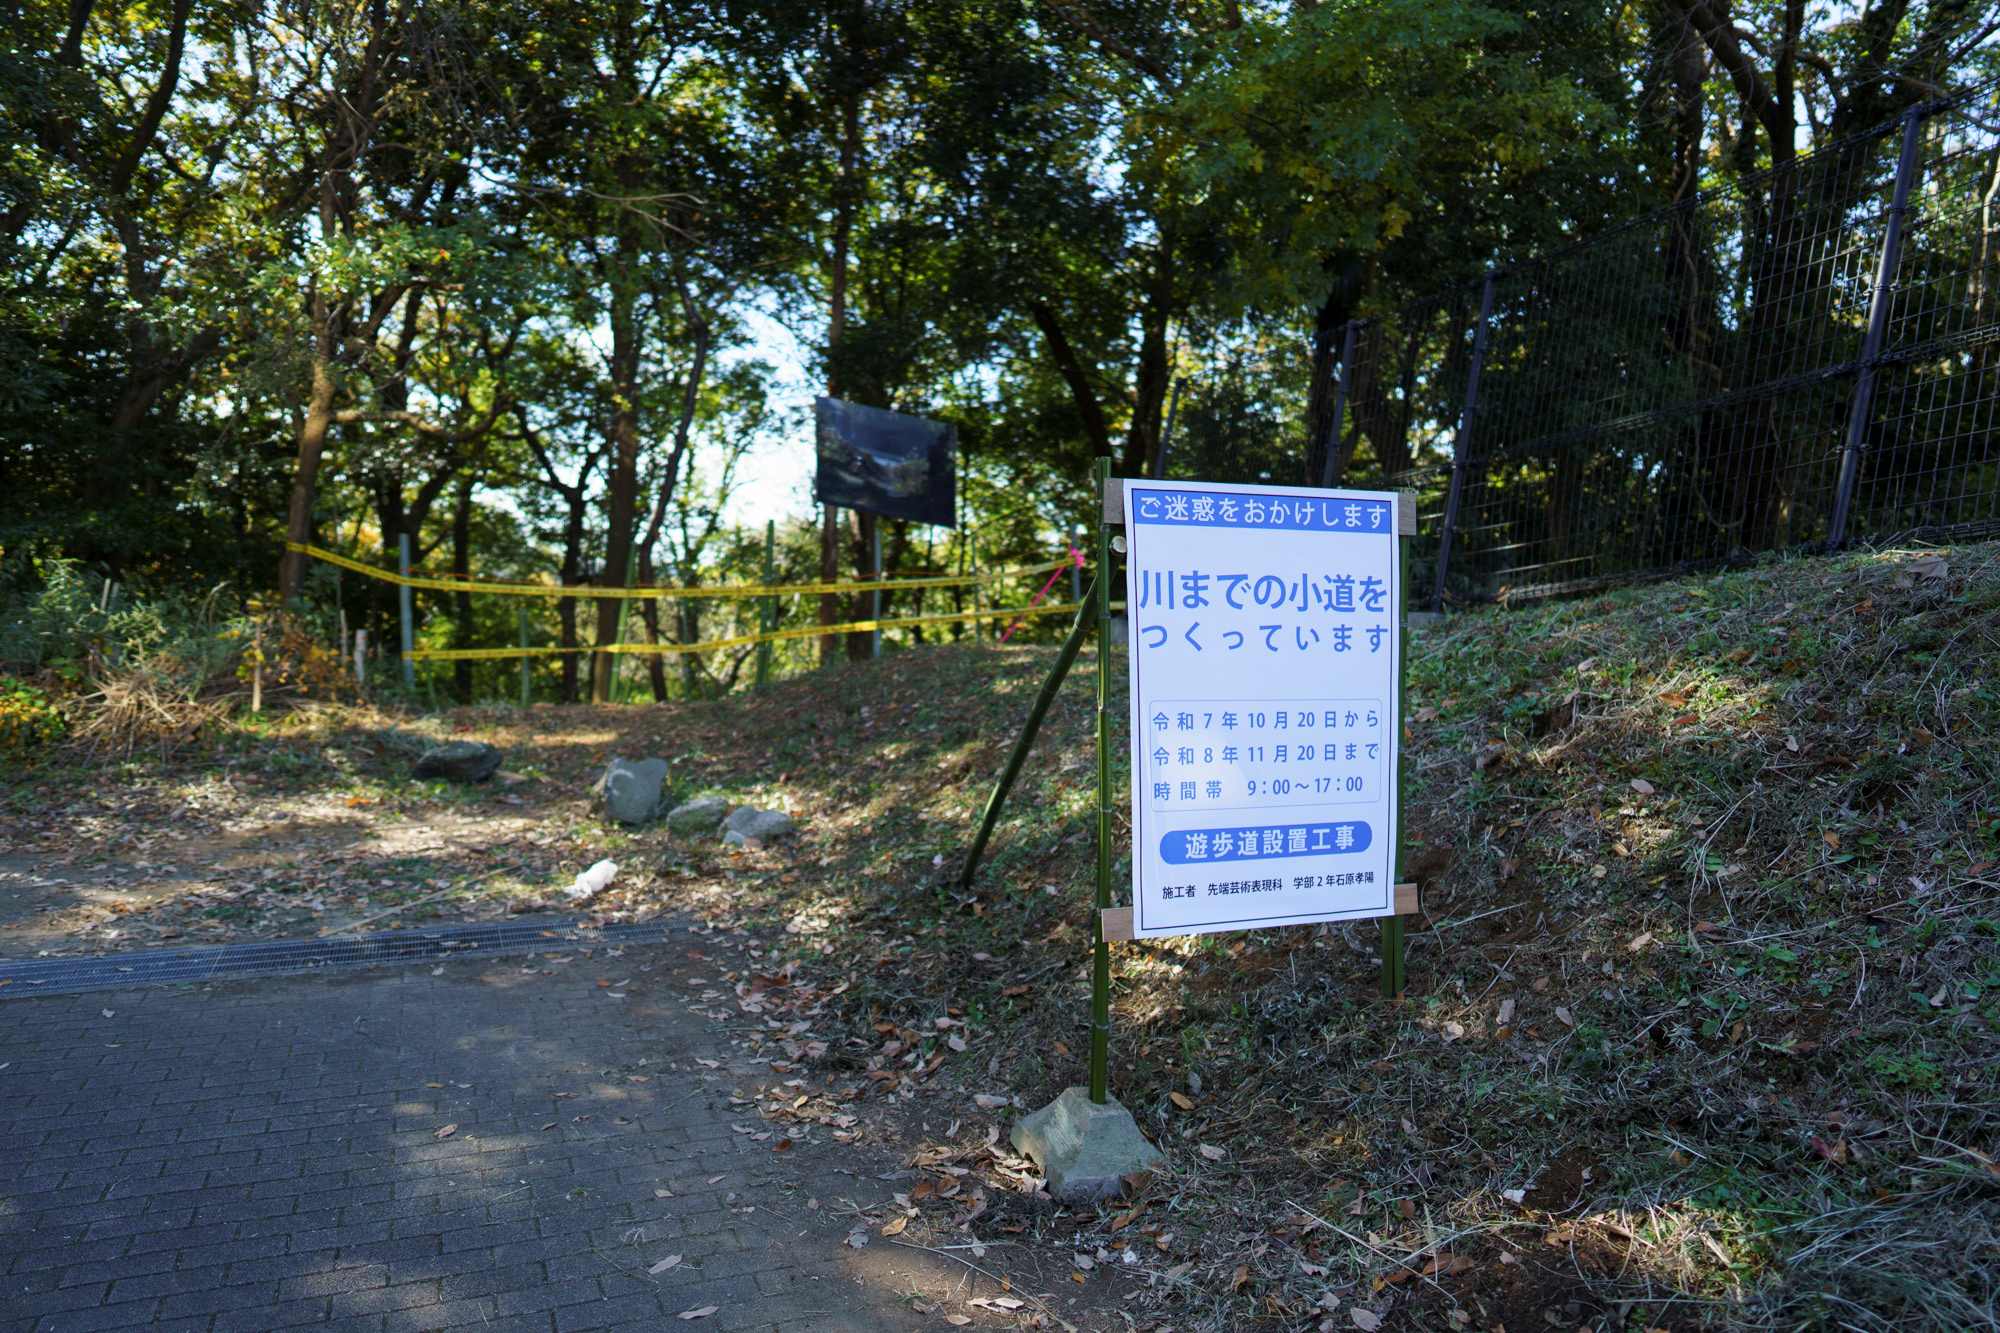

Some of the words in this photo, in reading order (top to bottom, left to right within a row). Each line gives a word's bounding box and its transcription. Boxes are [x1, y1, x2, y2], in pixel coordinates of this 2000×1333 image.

[1140, 495, 1387, 529] ご迷惑をおかけします
[1140, 570, 1388, 613] 川までの小道を
[1141, 621, 1388, 653] つくっています
[1152, 710, 1379, 731] 令和7年10月20日から
[1153, 743, 1379, 766] 令和8年11月20日まで
[1153, 780, 1223, 801] 時間帯
[1185, 825, 1355, 860] 遊歩道設置工事
[1162, 885, 1196, 900] 施工者
[1207, 877, 1283, 897] 先端芸術表現科
